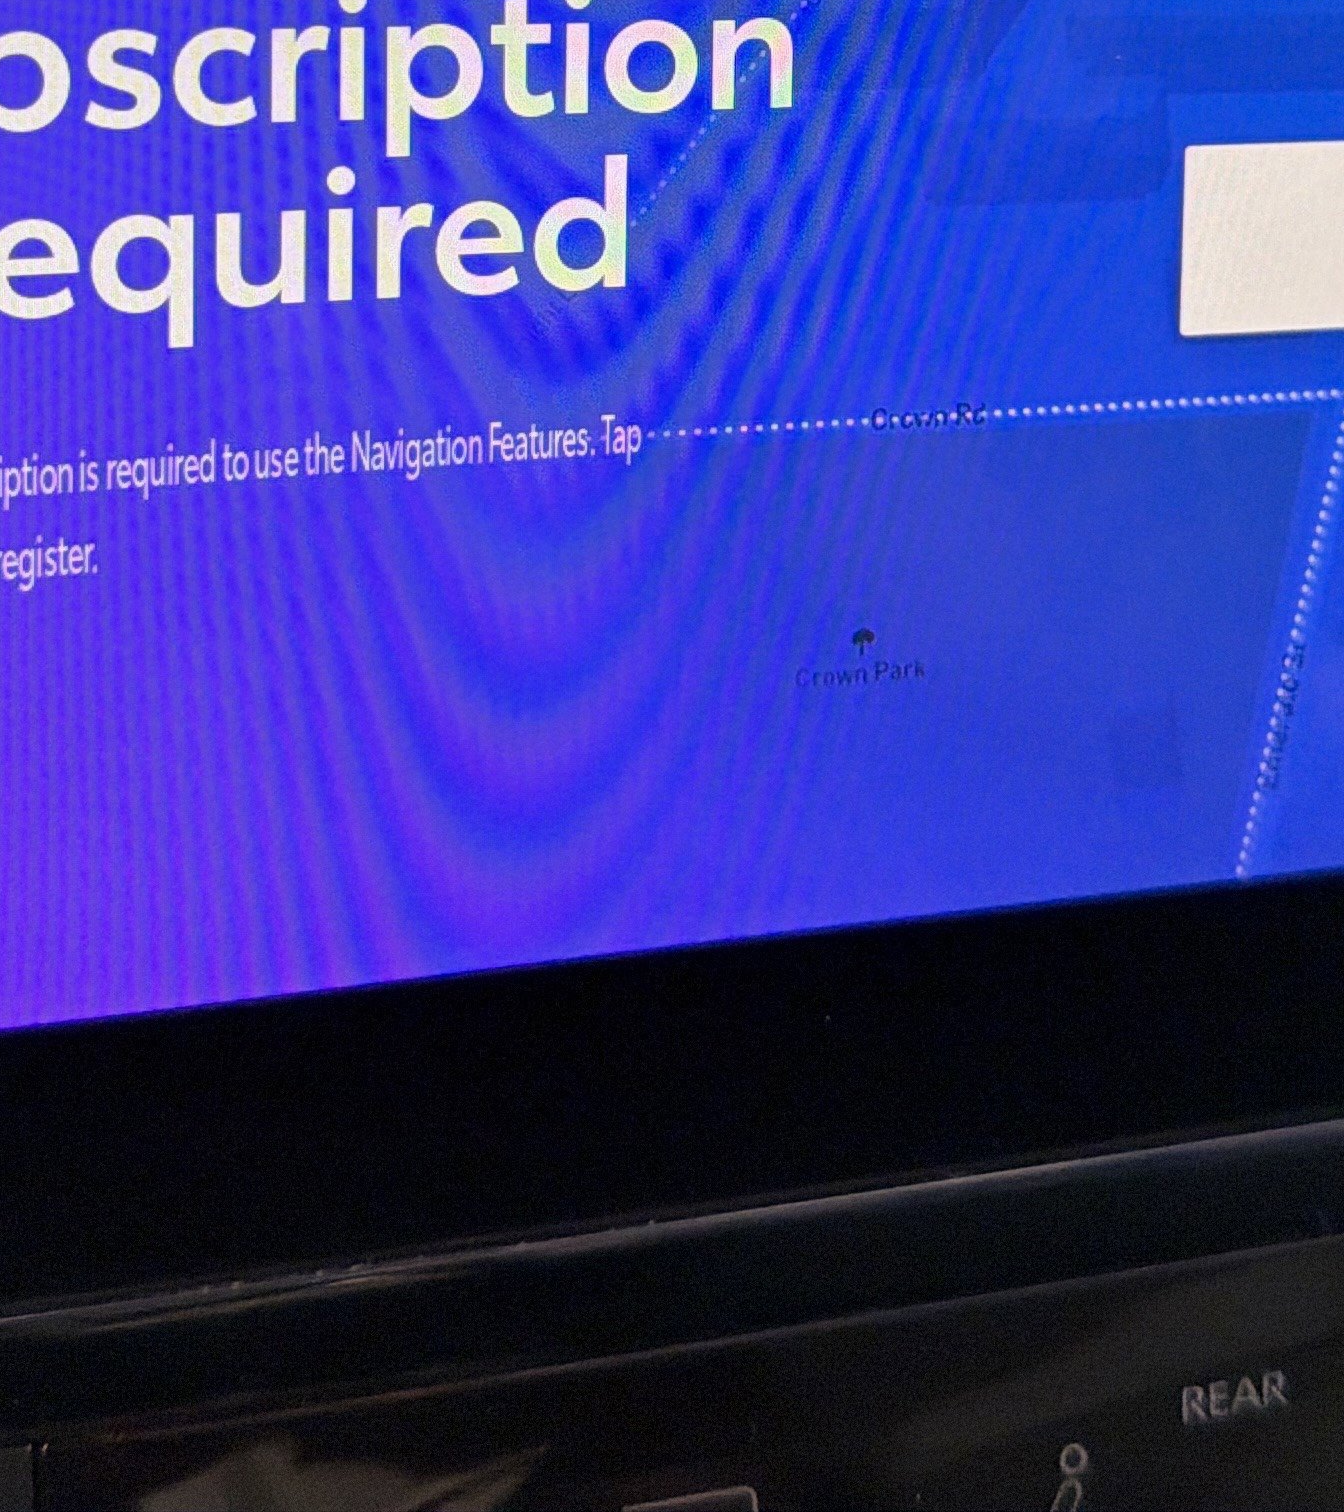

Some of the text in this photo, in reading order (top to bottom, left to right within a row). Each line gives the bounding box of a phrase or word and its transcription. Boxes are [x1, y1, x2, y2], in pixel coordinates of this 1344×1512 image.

[79, 448, 99, 493] is
[106, 438, 216, 501] required
[222, 443, 250, 482] to
[254, 446, 300, 480] use
[304, 430, 346, 476] the
[351, 425, 484, 481] Navigation
[488, 420, 597, 464] Features.
[600, 414, 642, 467] Tap
[794, 659, 926, 688] Crown Park
[1179, 1368, 1290, 1426] REAR
